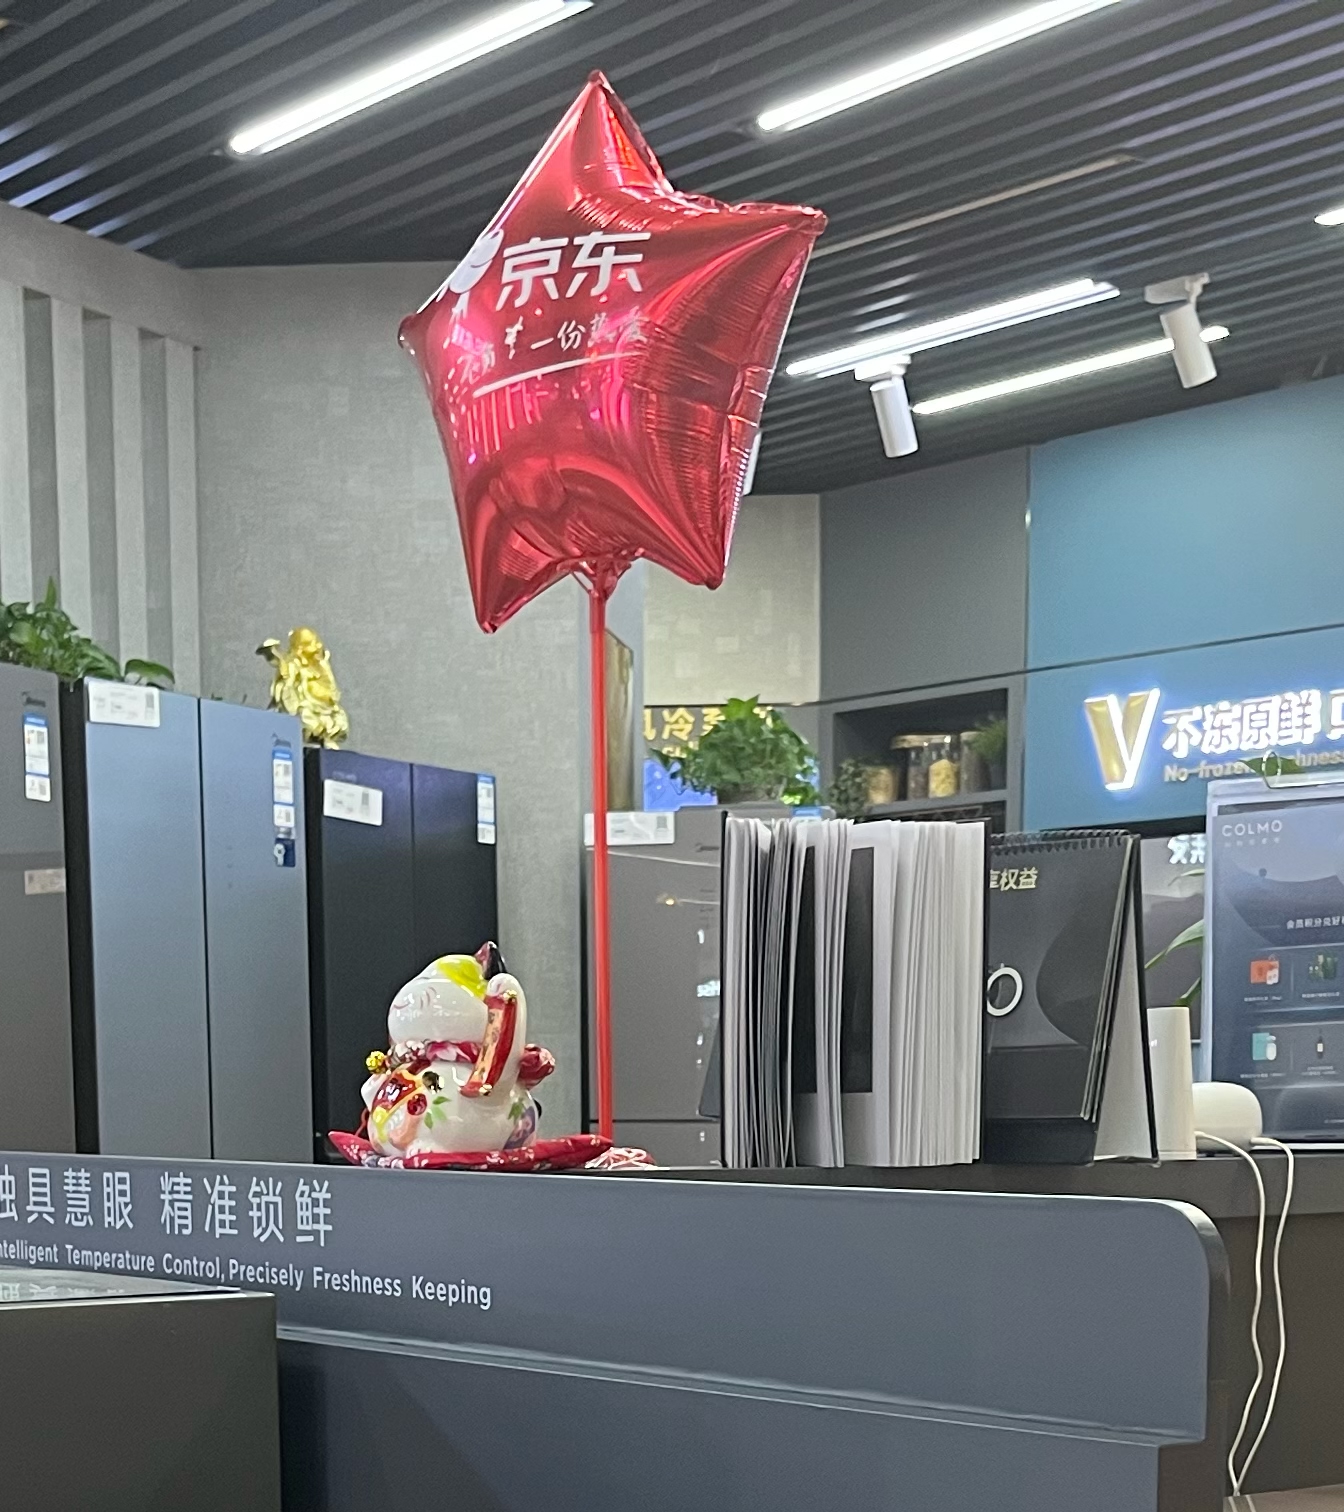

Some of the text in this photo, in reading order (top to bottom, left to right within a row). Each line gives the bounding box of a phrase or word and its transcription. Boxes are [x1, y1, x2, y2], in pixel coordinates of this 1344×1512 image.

[496, 231, 652, 312] 京东
[1161, 687, 1322, 760] 不冻原鲜
[1221, 818, 1284, 838] COLMO
[159, 1171, 334, 1248] 精准锁鲜
[65, 1244, 156, 1274] Temperature
[313, 1266, 402, 1298] Freshness
[411, 1275, 493, 1311] Keeping
